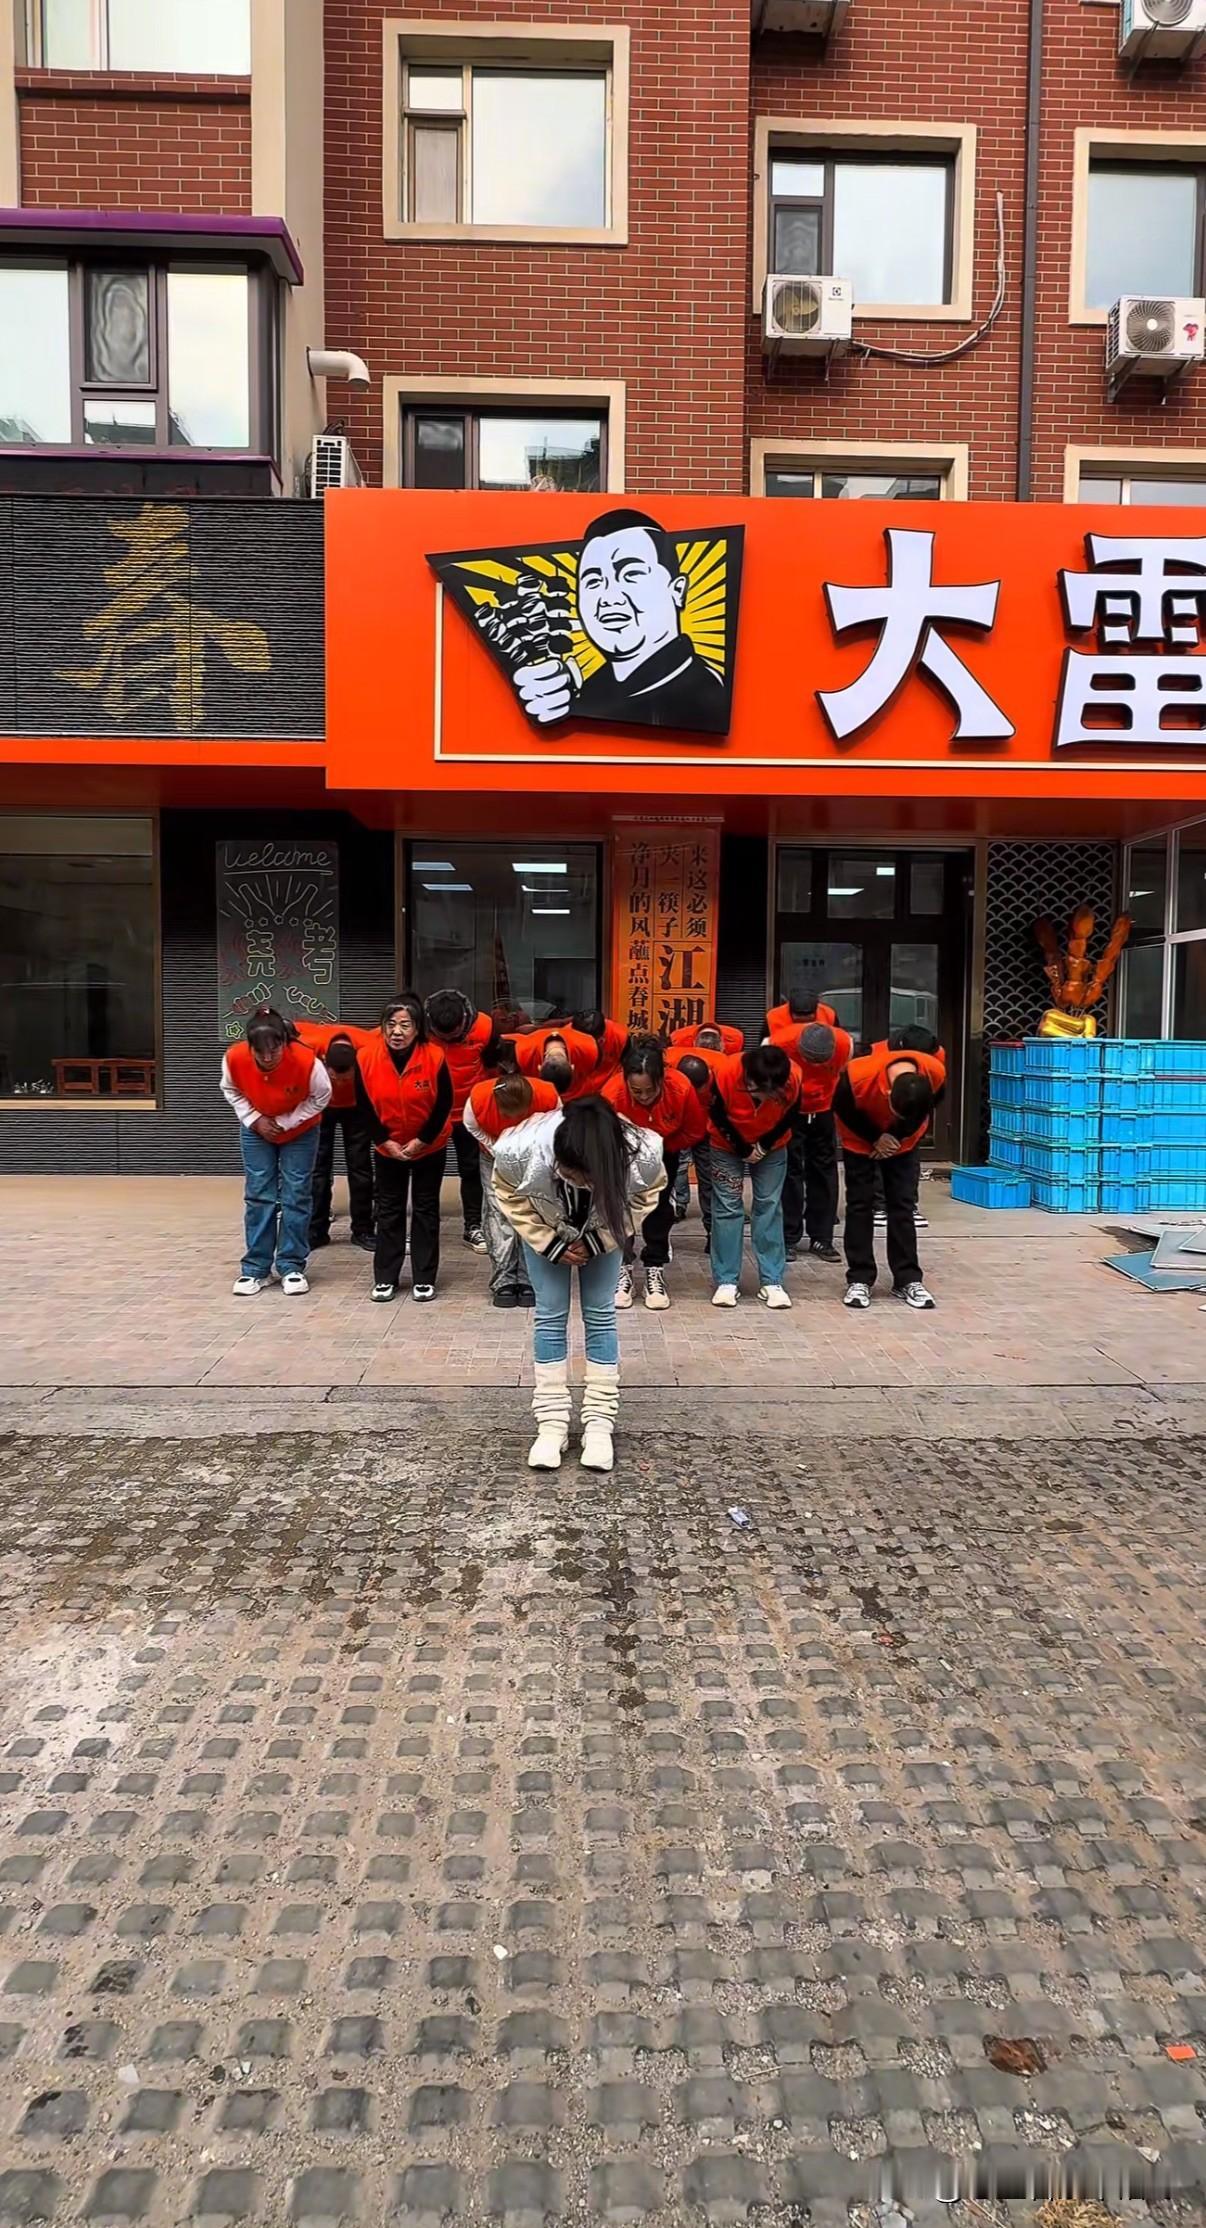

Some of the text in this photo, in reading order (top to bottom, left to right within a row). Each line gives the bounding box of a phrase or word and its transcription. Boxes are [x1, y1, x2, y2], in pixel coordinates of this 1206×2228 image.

[814, 527, 1206, 750] 大雷
[627, 842, 652, 1037] 净月的风蘸点春城
[686, 844, 708, 938] 来这必须
